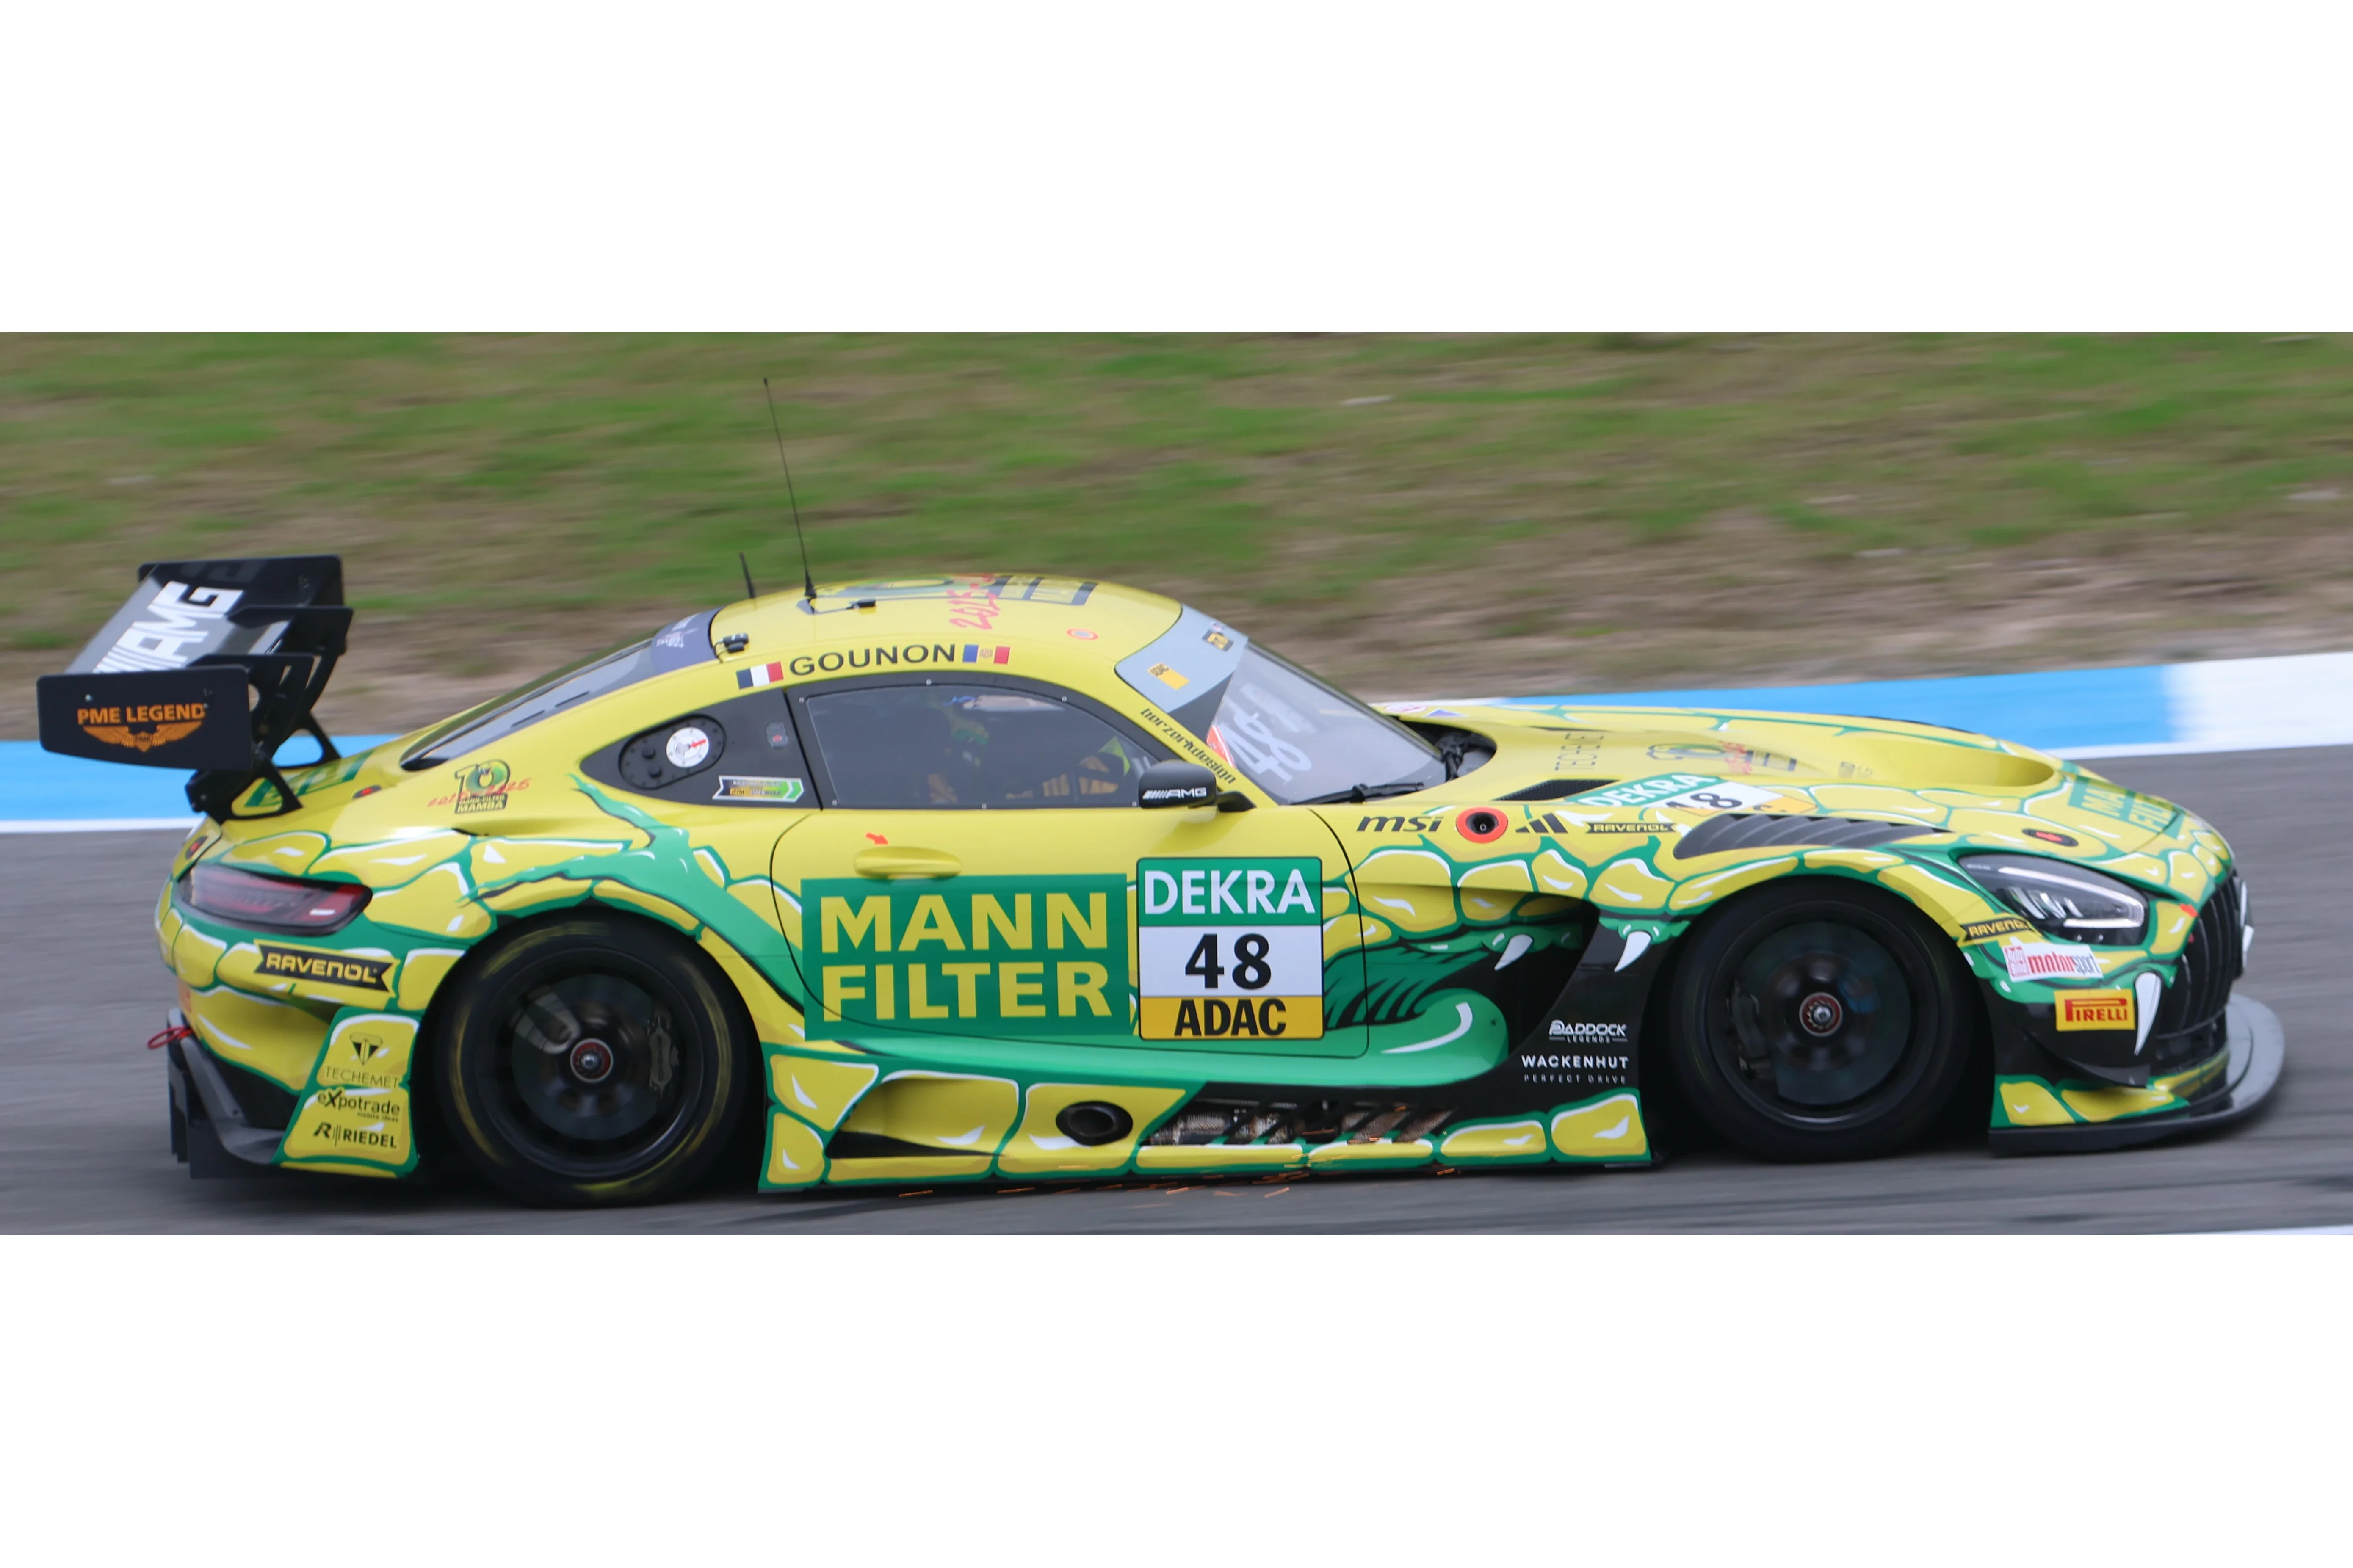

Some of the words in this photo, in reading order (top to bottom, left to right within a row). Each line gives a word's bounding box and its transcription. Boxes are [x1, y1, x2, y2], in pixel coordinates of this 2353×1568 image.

[789, 644, 956, 676] GOUNON
[77, 707, 121, 725] PME
[126, 703, 206, 723] LEGEND
[1576, 773, 1717, 807] DEKRA
[1356, 816, 1444, 832] msi
[1593, 823, 1669, 834] RAVENOL
[1143, 869, 1316, 915] DEKRA
[820, 892, 1108, 954] MANN
[1968, 919, 2029, 936] RAVENO
[265, 952, 376, 984] RAVENOL
[1186, 933, 1272, 990] 48
[822, 960, 1112, 1022] FILTER
[1174, 998, 1287, 1037] ADAC
[2065, 998, 2128, 1022] PIRELLI
[1567, 1035, 1610, 1043] LEGENDS
[1521, 1054, 1629, 1070] WACKENHUT
[326, 1066, 399, 1088] TECHEMET
[1524, 1074, 1580, 1083] PERFECT
[1588, 1074, 1626, 1085] DRIVE
[343, 1128, 397, 1149] RIEDEL
